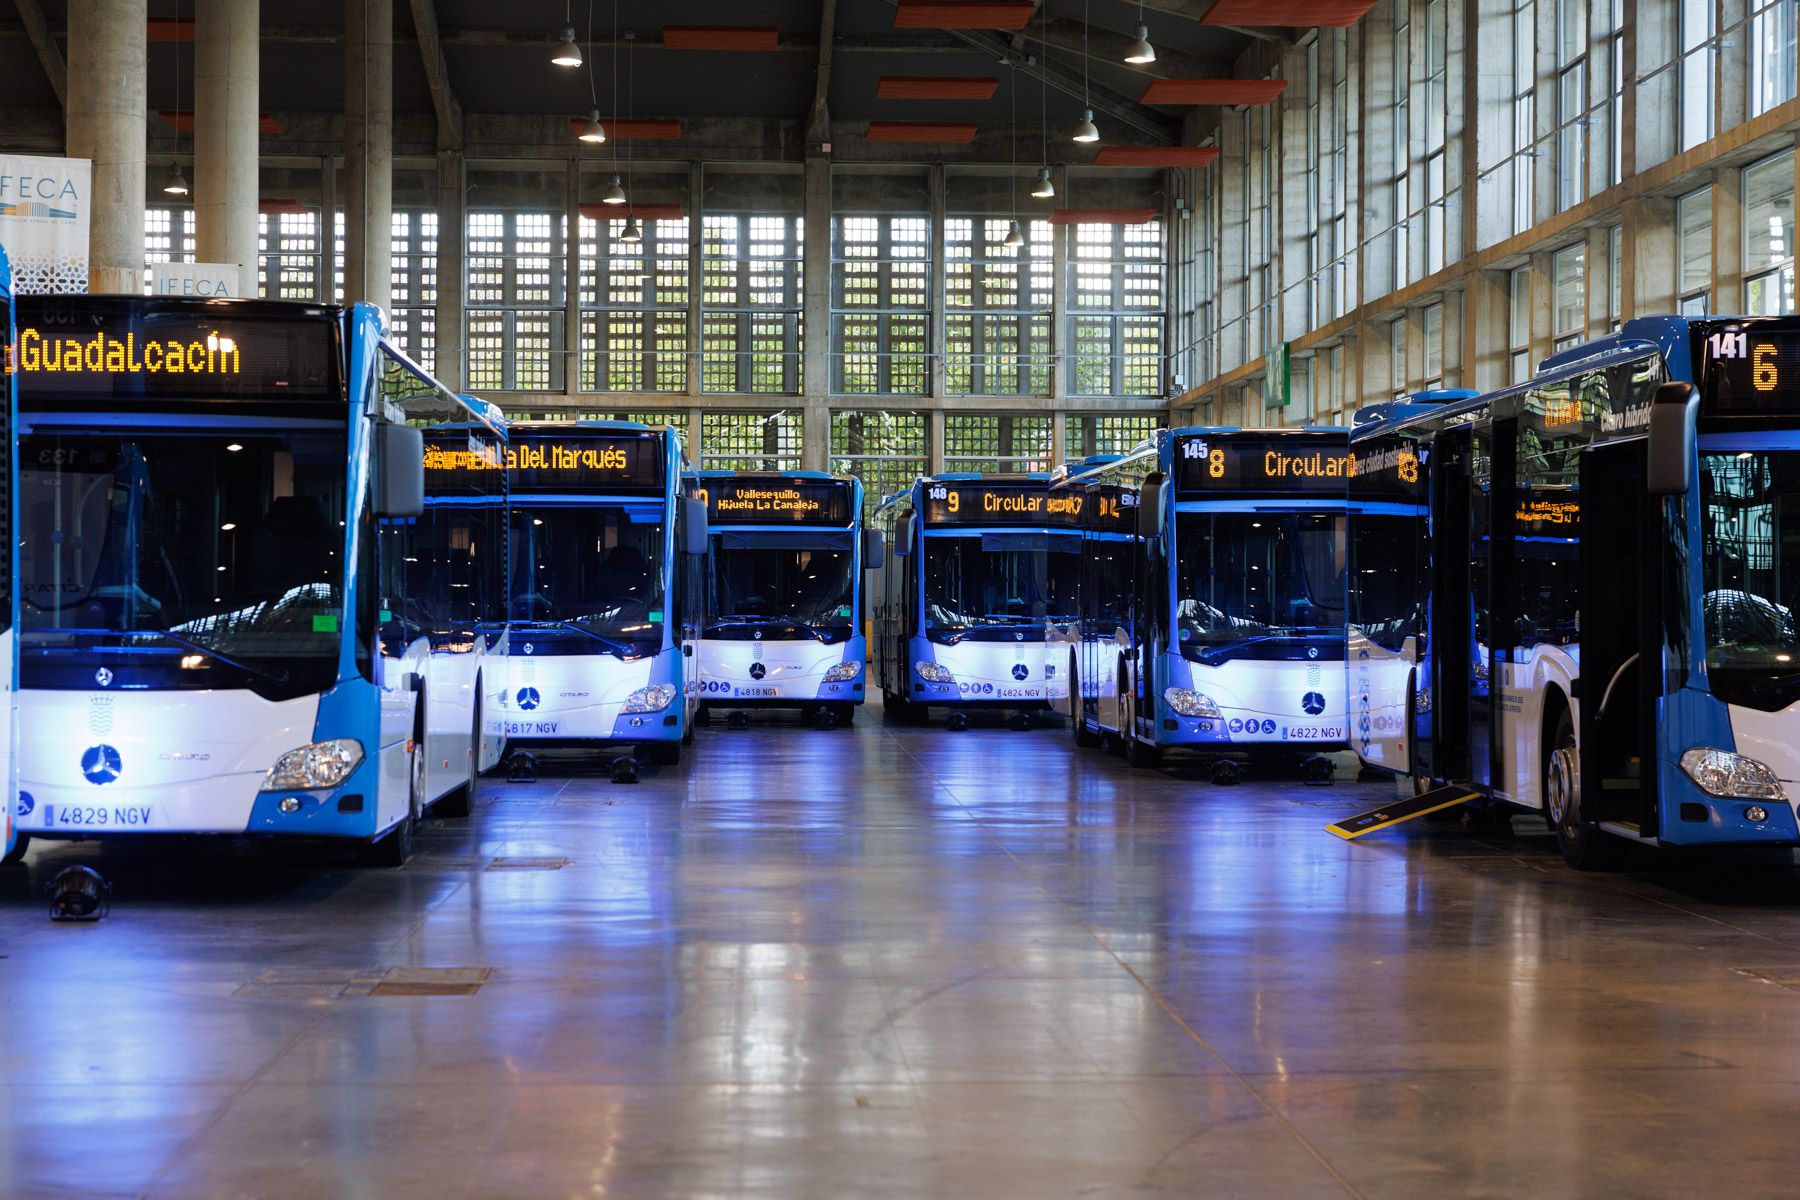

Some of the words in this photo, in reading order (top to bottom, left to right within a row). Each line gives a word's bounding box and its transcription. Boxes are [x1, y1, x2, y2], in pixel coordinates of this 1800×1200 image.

[160, 278, 229, 297] IFECA
[1709, 332, 1747, 359] 141
[1753, 344, 1778, 391] 6
[520, 444, 548, 469] Del
[552, 445, 627, 469] Marqués
[1182, 442, 1208, 459] 145
[1209, 449, 1225, 478] 8
[1265, 451, 1347, 477] Circular
[928, 487, 947, 500] 148
[947, 491, 960, 513] 9
[984, 492, 1043, 511] Circular
[718, 499, 754, 511] Hijuela
[756, 499, 771, 510] La
[773, 499, 819, 511] Canaleja
[740, 687, 761, 697] 4818
[762, 687, 778, 697] NGV
[1002, 688, 1023, 697] 4824
[1024, 688, 1040, 697] NGV
[536, 722, 558, 734] NGV
[1290, 727, 1318, 738] 4822
[1321, 727, 1342, 738] NGV
[60, 807, 108, 825] 4829
[115, 807, 150, 825] NGV
